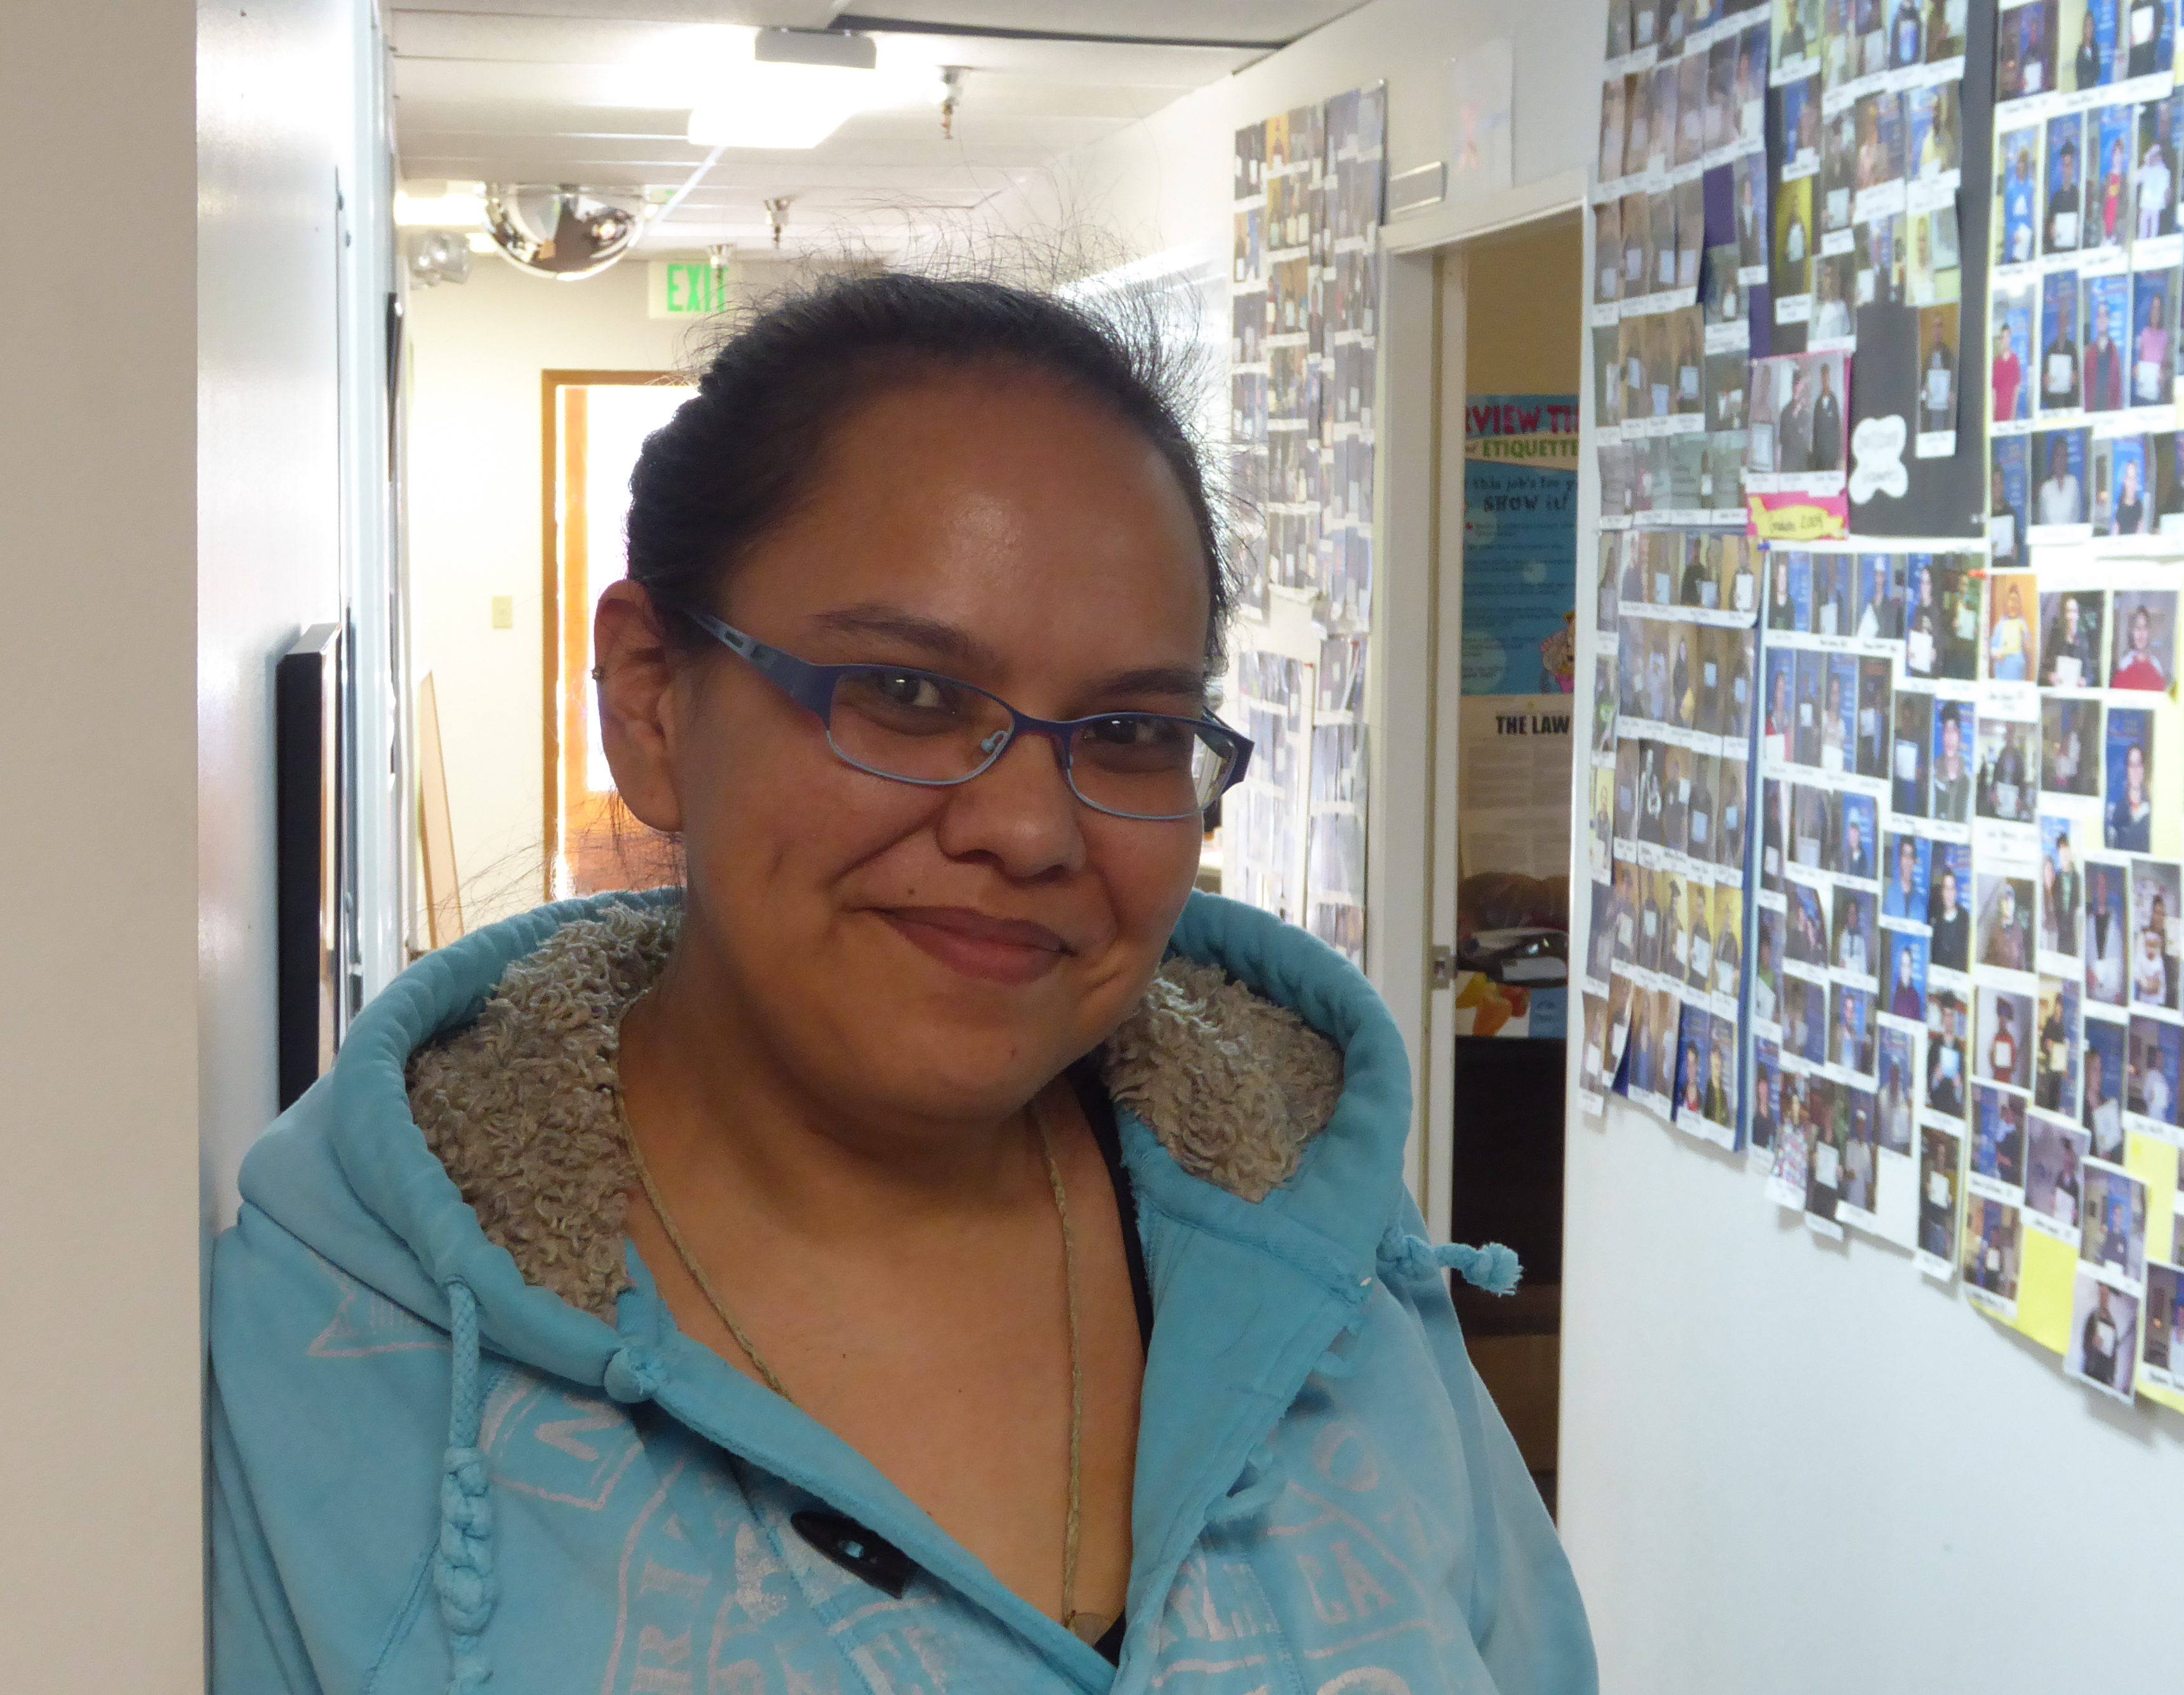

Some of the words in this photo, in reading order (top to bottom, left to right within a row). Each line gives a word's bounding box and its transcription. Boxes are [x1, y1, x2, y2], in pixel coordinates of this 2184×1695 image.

[667, 263, 729, 313] EXIT
[1483, 495, 1539, 512] SHOW
[1495, 712, 1528, 736] THE
[1531, 712, 1571, 735] LAW
